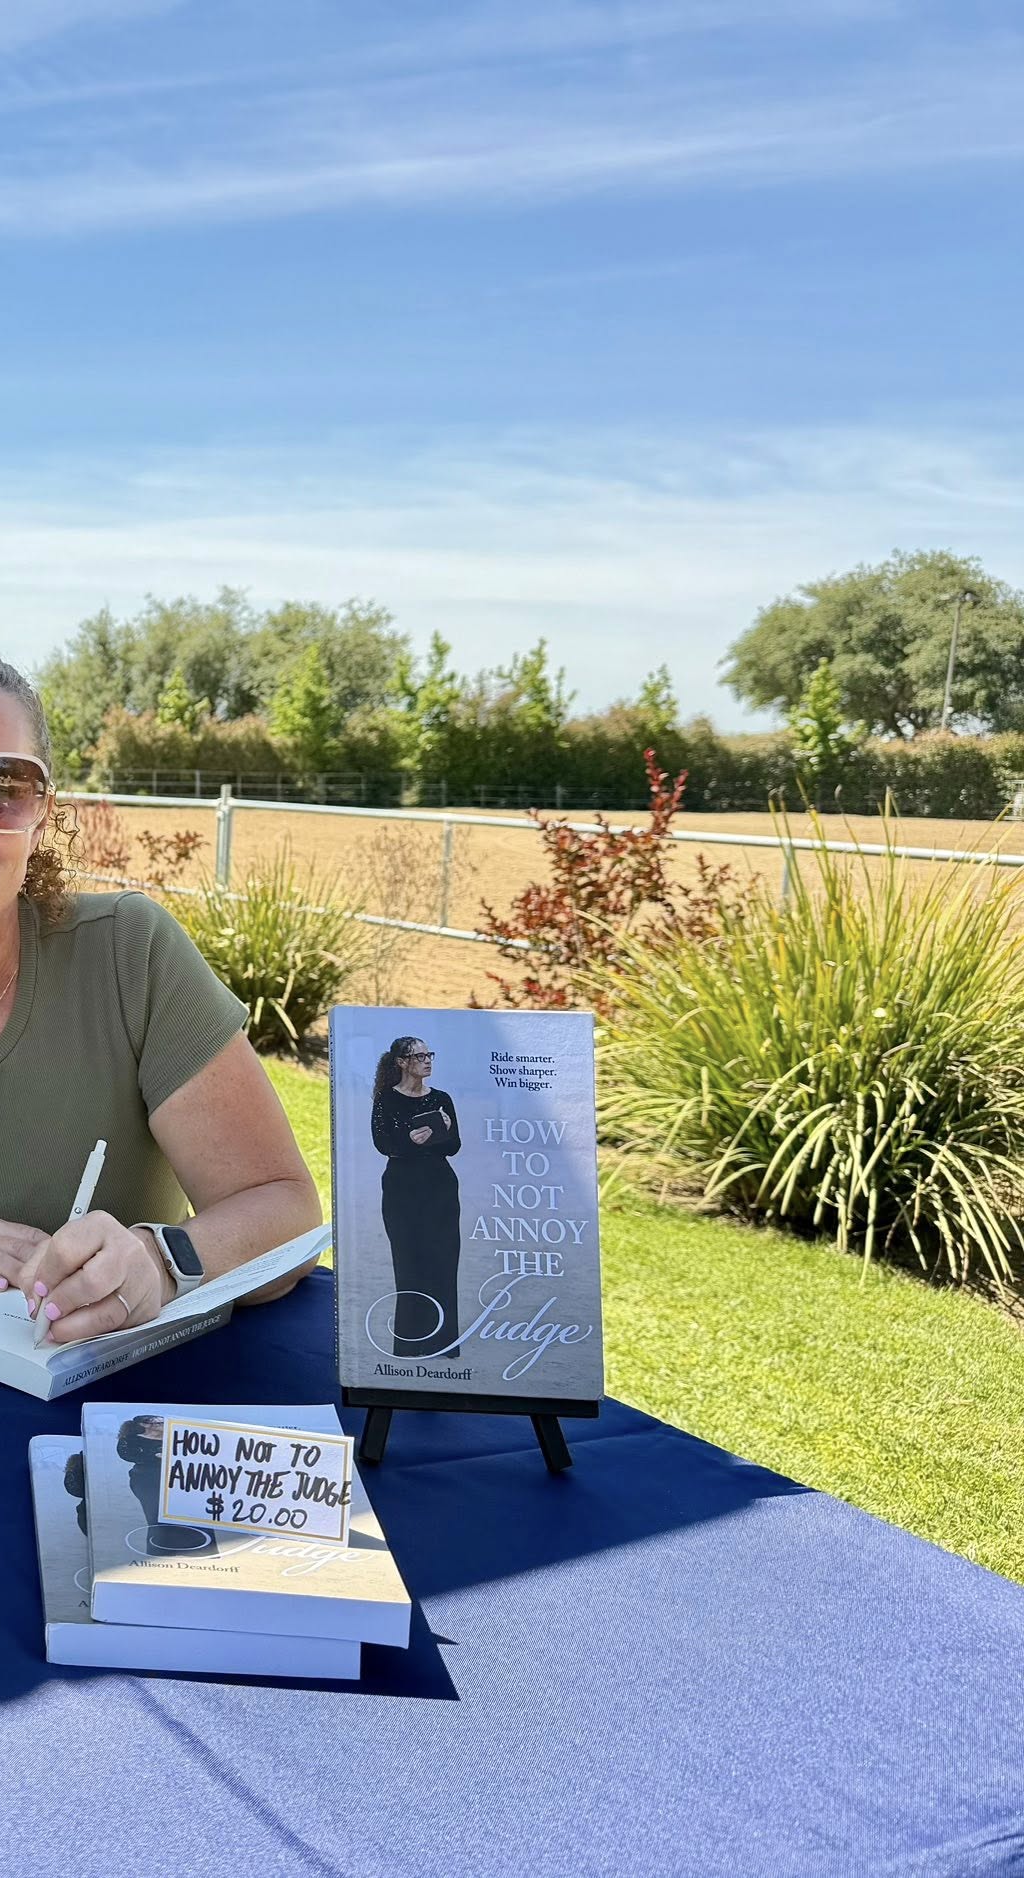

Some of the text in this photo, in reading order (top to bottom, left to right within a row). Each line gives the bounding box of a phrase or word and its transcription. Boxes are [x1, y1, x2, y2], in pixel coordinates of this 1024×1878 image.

[489, 1064, 557, 1079] Show sharper.
[491, 1051, 555, 1064] Ride smarter.
[495, 1077, 553, 1092] Win bigger.
[483, 1118, 569, 1146] HOW
[501, 1150, 550, 1178] TO
[491, 1183, 564, 1211] NOT
[469, 1216, 589, 1245] ANNOY
[494, 1249, 565, 1278] THE
[374, 1363, 473, 1380] Allison Deardorff
[173, 1429, 321, 1468] HOW NOT TO
[168, 1460, 352, 1508] ANNOY THE JUDGE
[128, 1559, 241, 1573] Allison Deardorff
